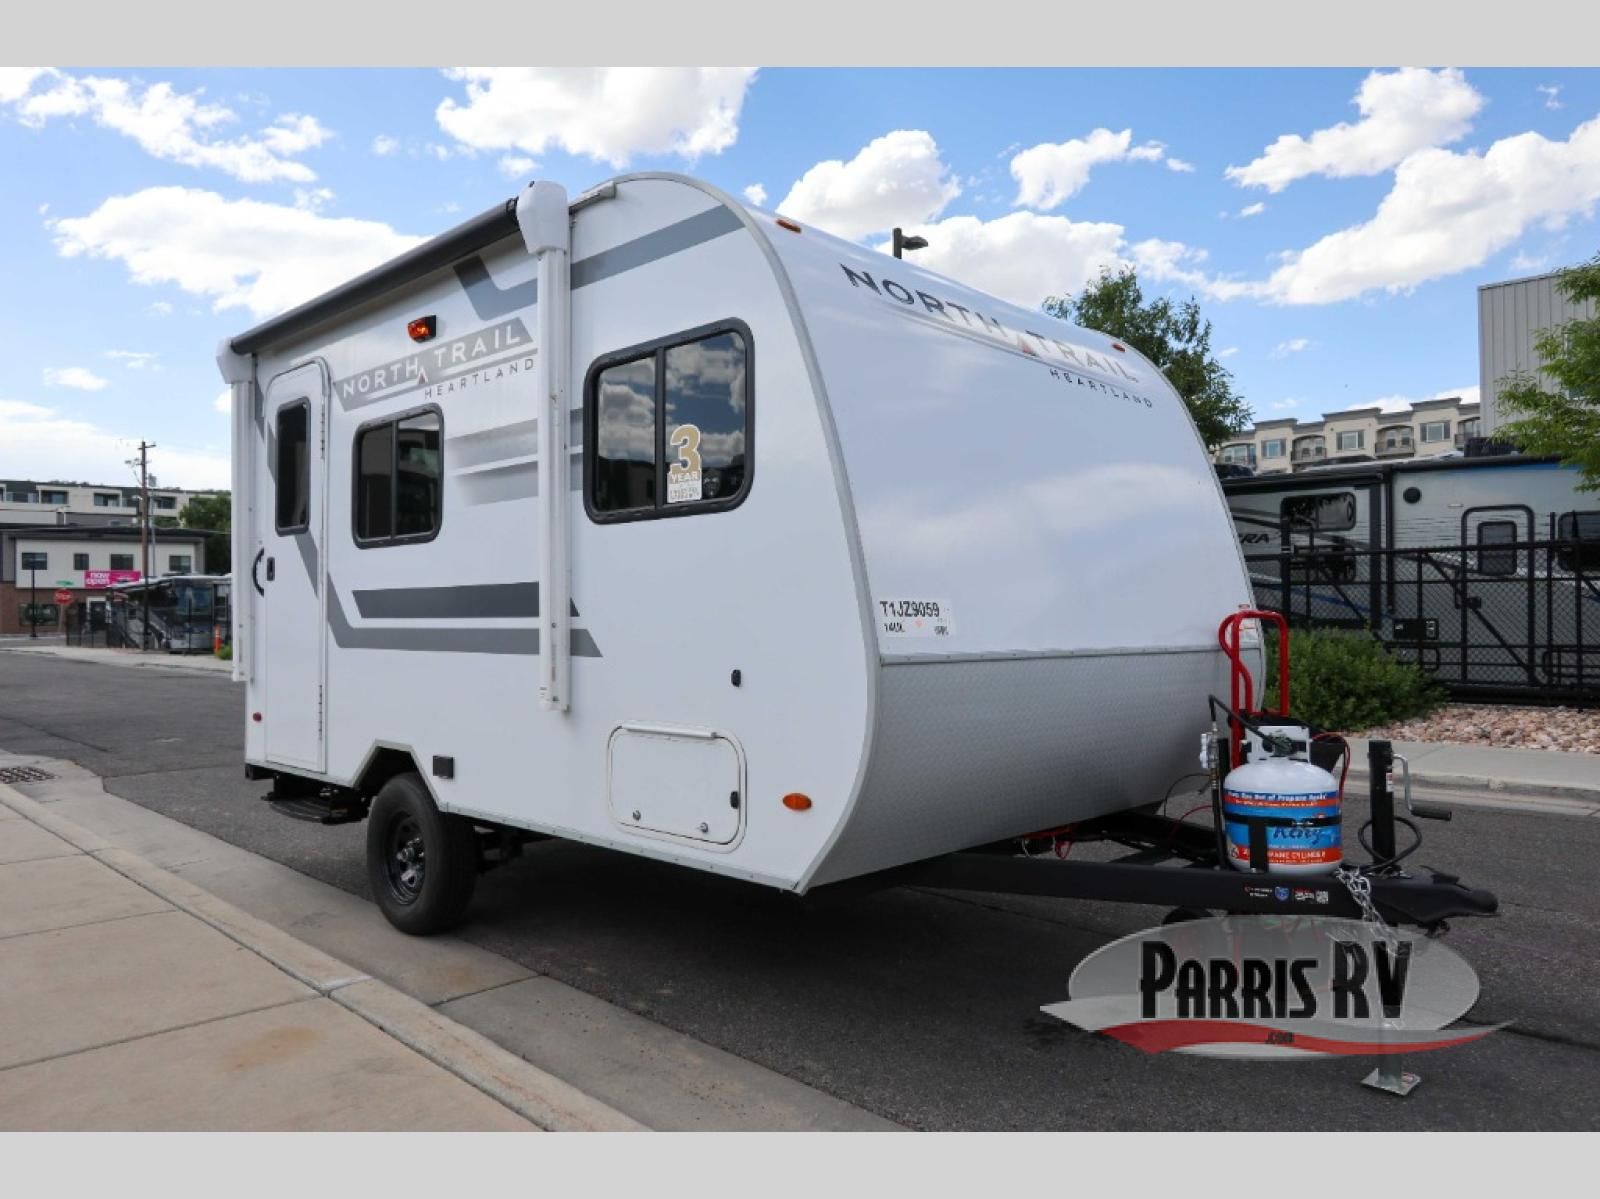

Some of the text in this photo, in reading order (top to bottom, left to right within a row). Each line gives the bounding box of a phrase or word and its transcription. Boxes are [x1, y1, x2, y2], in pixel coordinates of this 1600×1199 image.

[840, 263, 1139, 383] NORTH TRAIL
[343, 324, 521, 399] NORTH TRAIL
[424, 357, 534, 400] HEARTLAND
[670, 424, 702, 474] 3
[671, 471, 699, 484] YEAR
[879, 600, 940, 618] T1JZ9059
